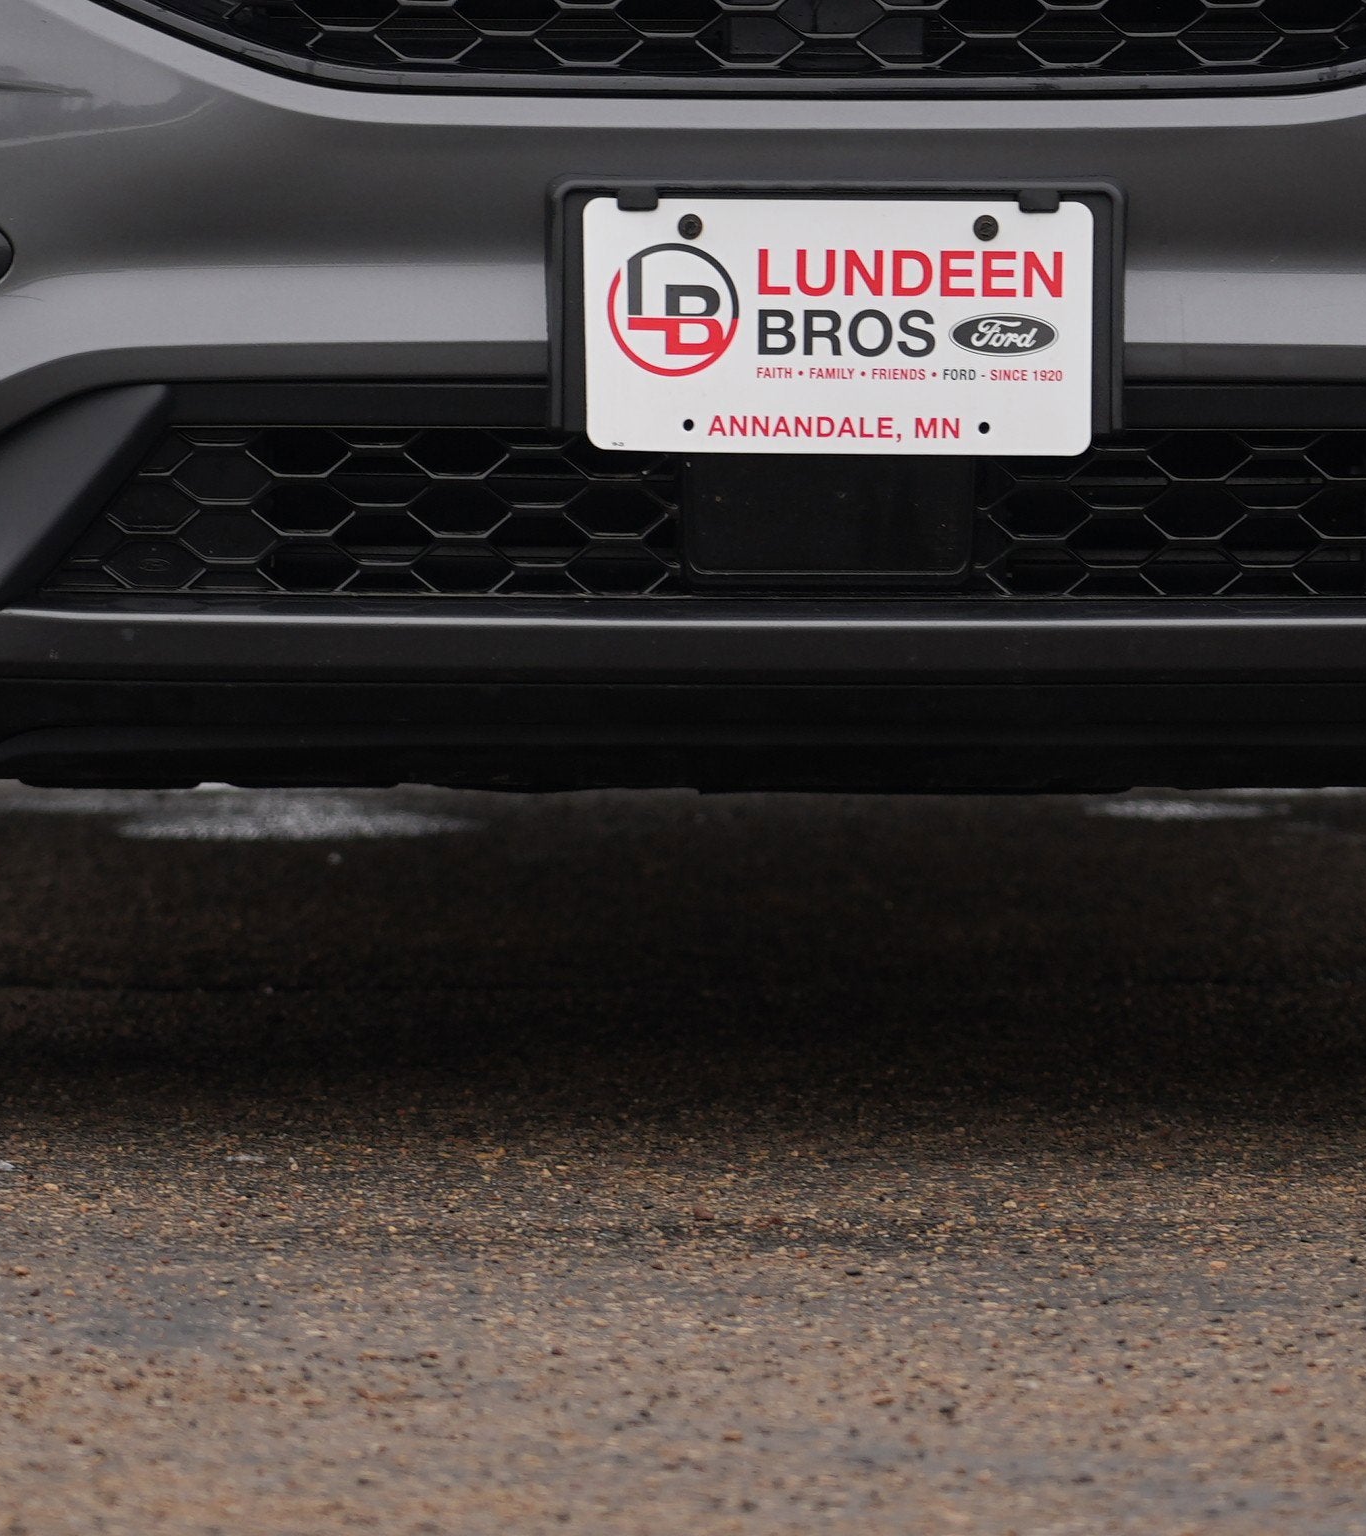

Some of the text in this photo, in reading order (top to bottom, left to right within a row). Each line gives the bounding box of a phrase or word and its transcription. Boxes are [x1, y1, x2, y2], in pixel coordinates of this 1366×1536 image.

[757, 248, 1064, 299] LUNDEEN
[757, 308, 936, 358] BROS
[970, 318, 1038, 349] Ford
[756, 366, 1063, 382] FAITH FAMILY FRIENDS FORD SINCE 1920
[707, 414, 961, 443] ANNANDALE, MN
